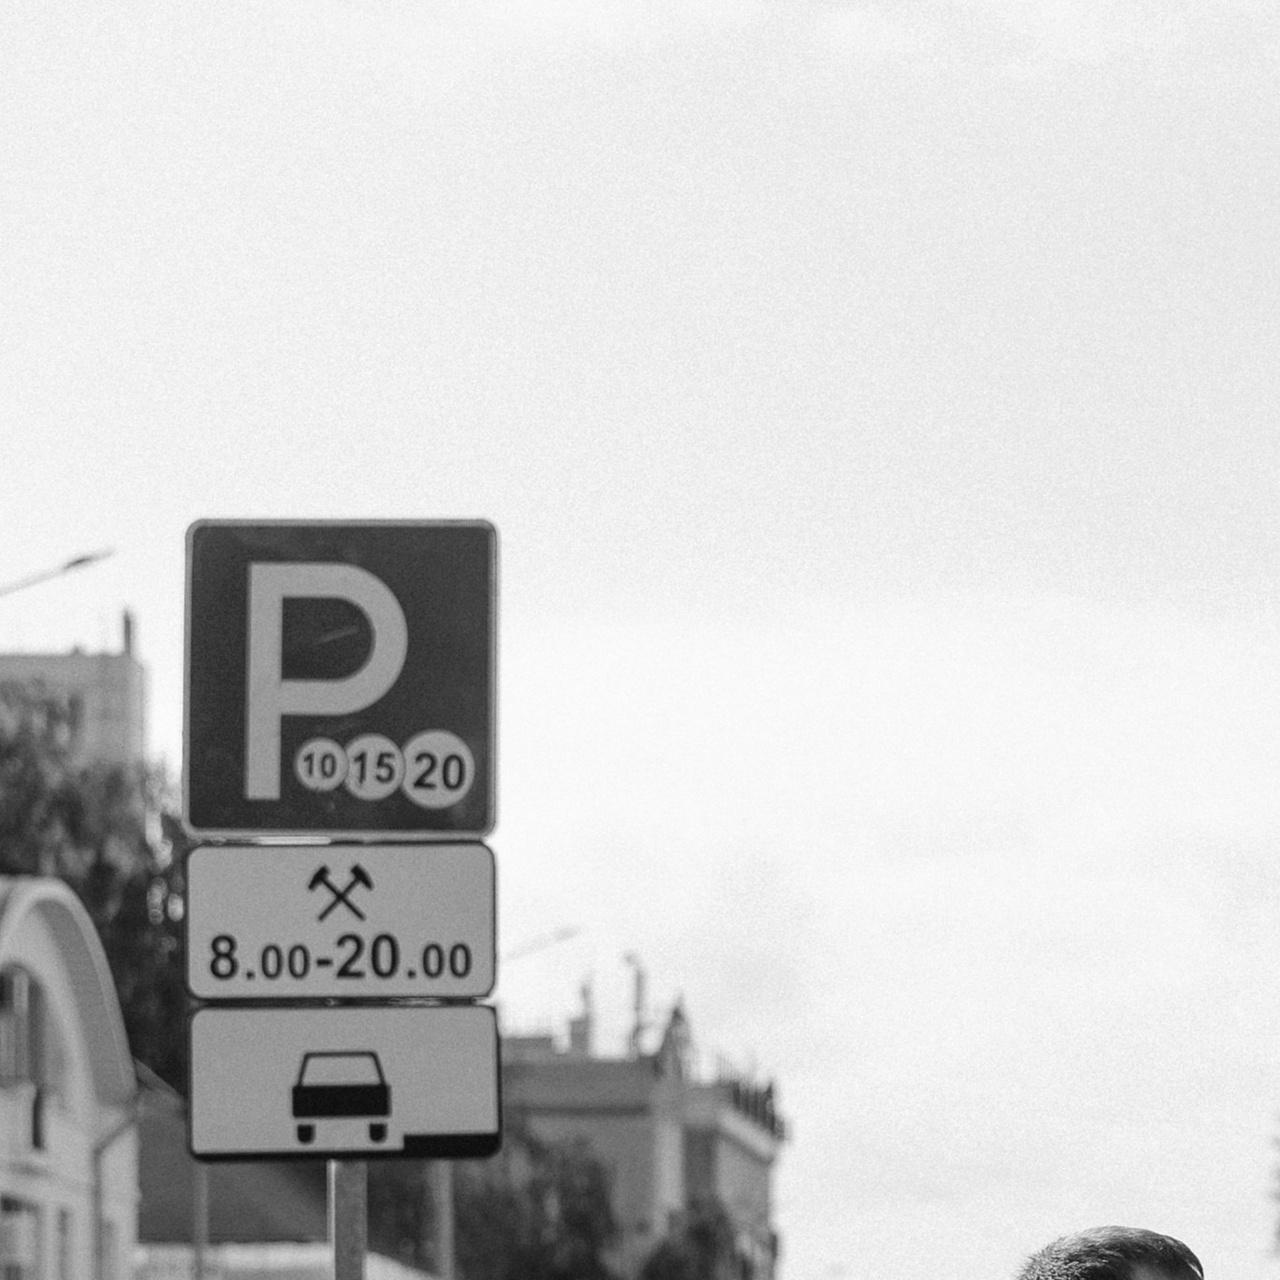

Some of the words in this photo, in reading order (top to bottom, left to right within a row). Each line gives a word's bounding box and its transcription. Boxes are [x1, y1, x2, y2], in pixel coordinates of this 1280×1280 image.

[245, 561, 409, 800] P
[303, 752, 337, 779] 10
[354, 751, 396, 786] 15
[413, 752, 467, 791] 20
[210, 934, 472, 980] 8.00-20.00
